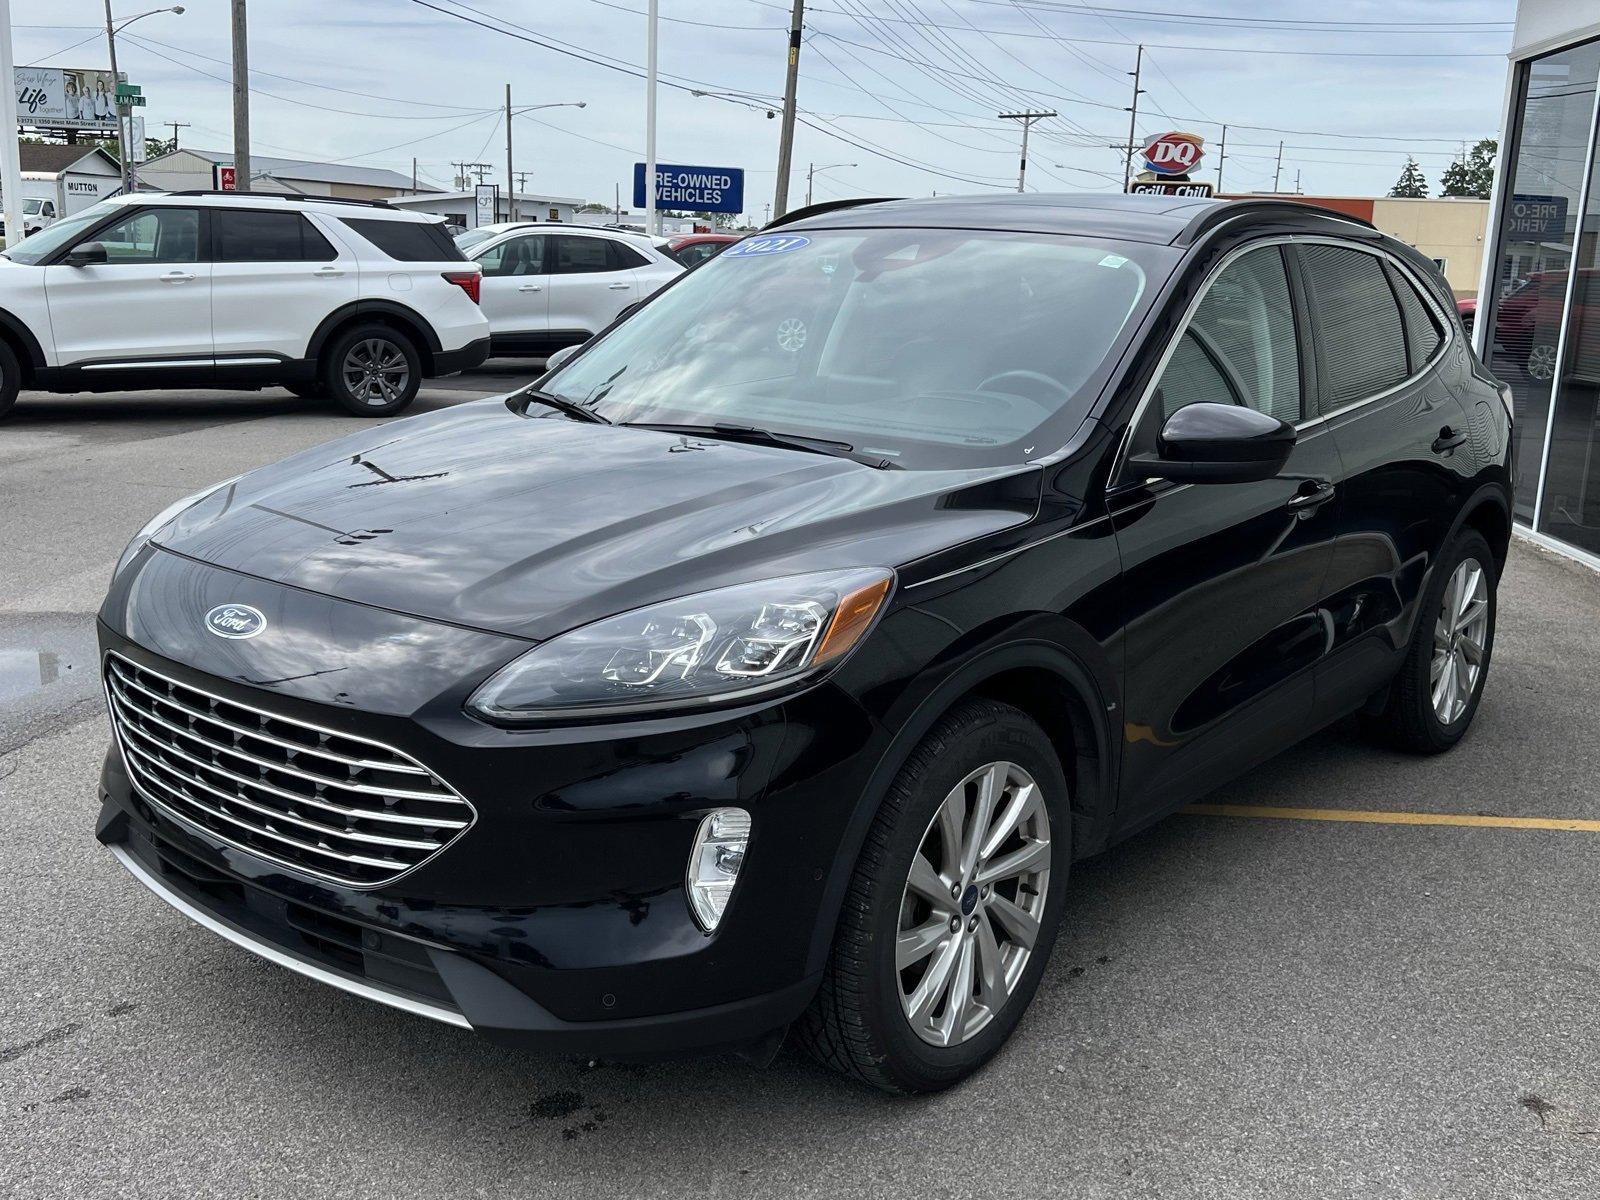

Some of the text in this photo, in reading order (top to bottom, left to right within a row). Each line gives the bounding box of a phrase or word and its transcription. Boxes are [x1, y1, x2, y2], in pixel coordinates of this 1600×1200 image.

[19, 87, 47, 113] Life
[1153, 142, 1195, 166] DQ
[67, 182, 98, 192] MUTTON
[645, 171, 731, 190] RE-OWNED
[1134, 185, 1166, 196] Grill
[1175, 186, 1209, 199] Chill
[728, 238, 802, 256] 2021
[213, 607, 252, 631] Ford
